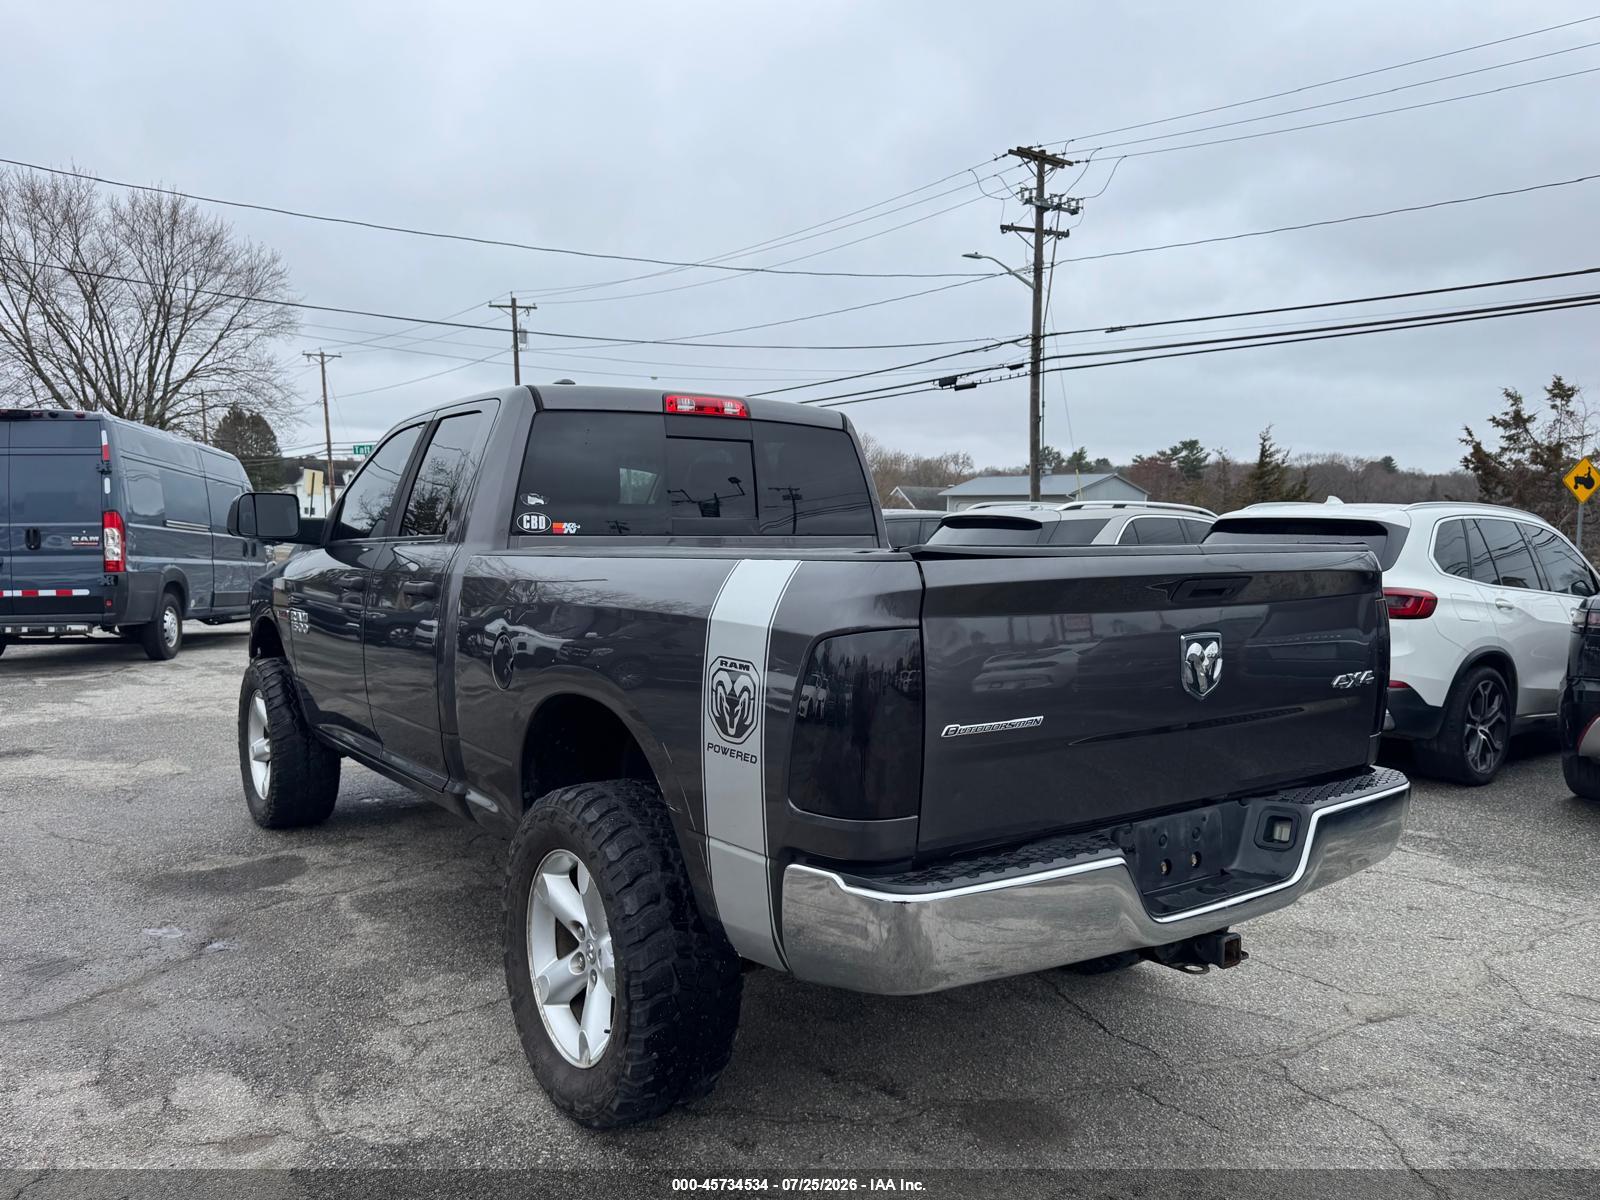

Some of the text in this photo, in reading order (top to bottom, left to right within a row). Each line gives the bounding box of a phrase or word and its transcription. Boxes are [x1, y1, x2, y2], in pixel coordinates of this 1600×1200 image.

[522, 514, 546, 530] CBD
[719, 659, 751, 672] RAM
[706, 742, 758, 765] POWERED
